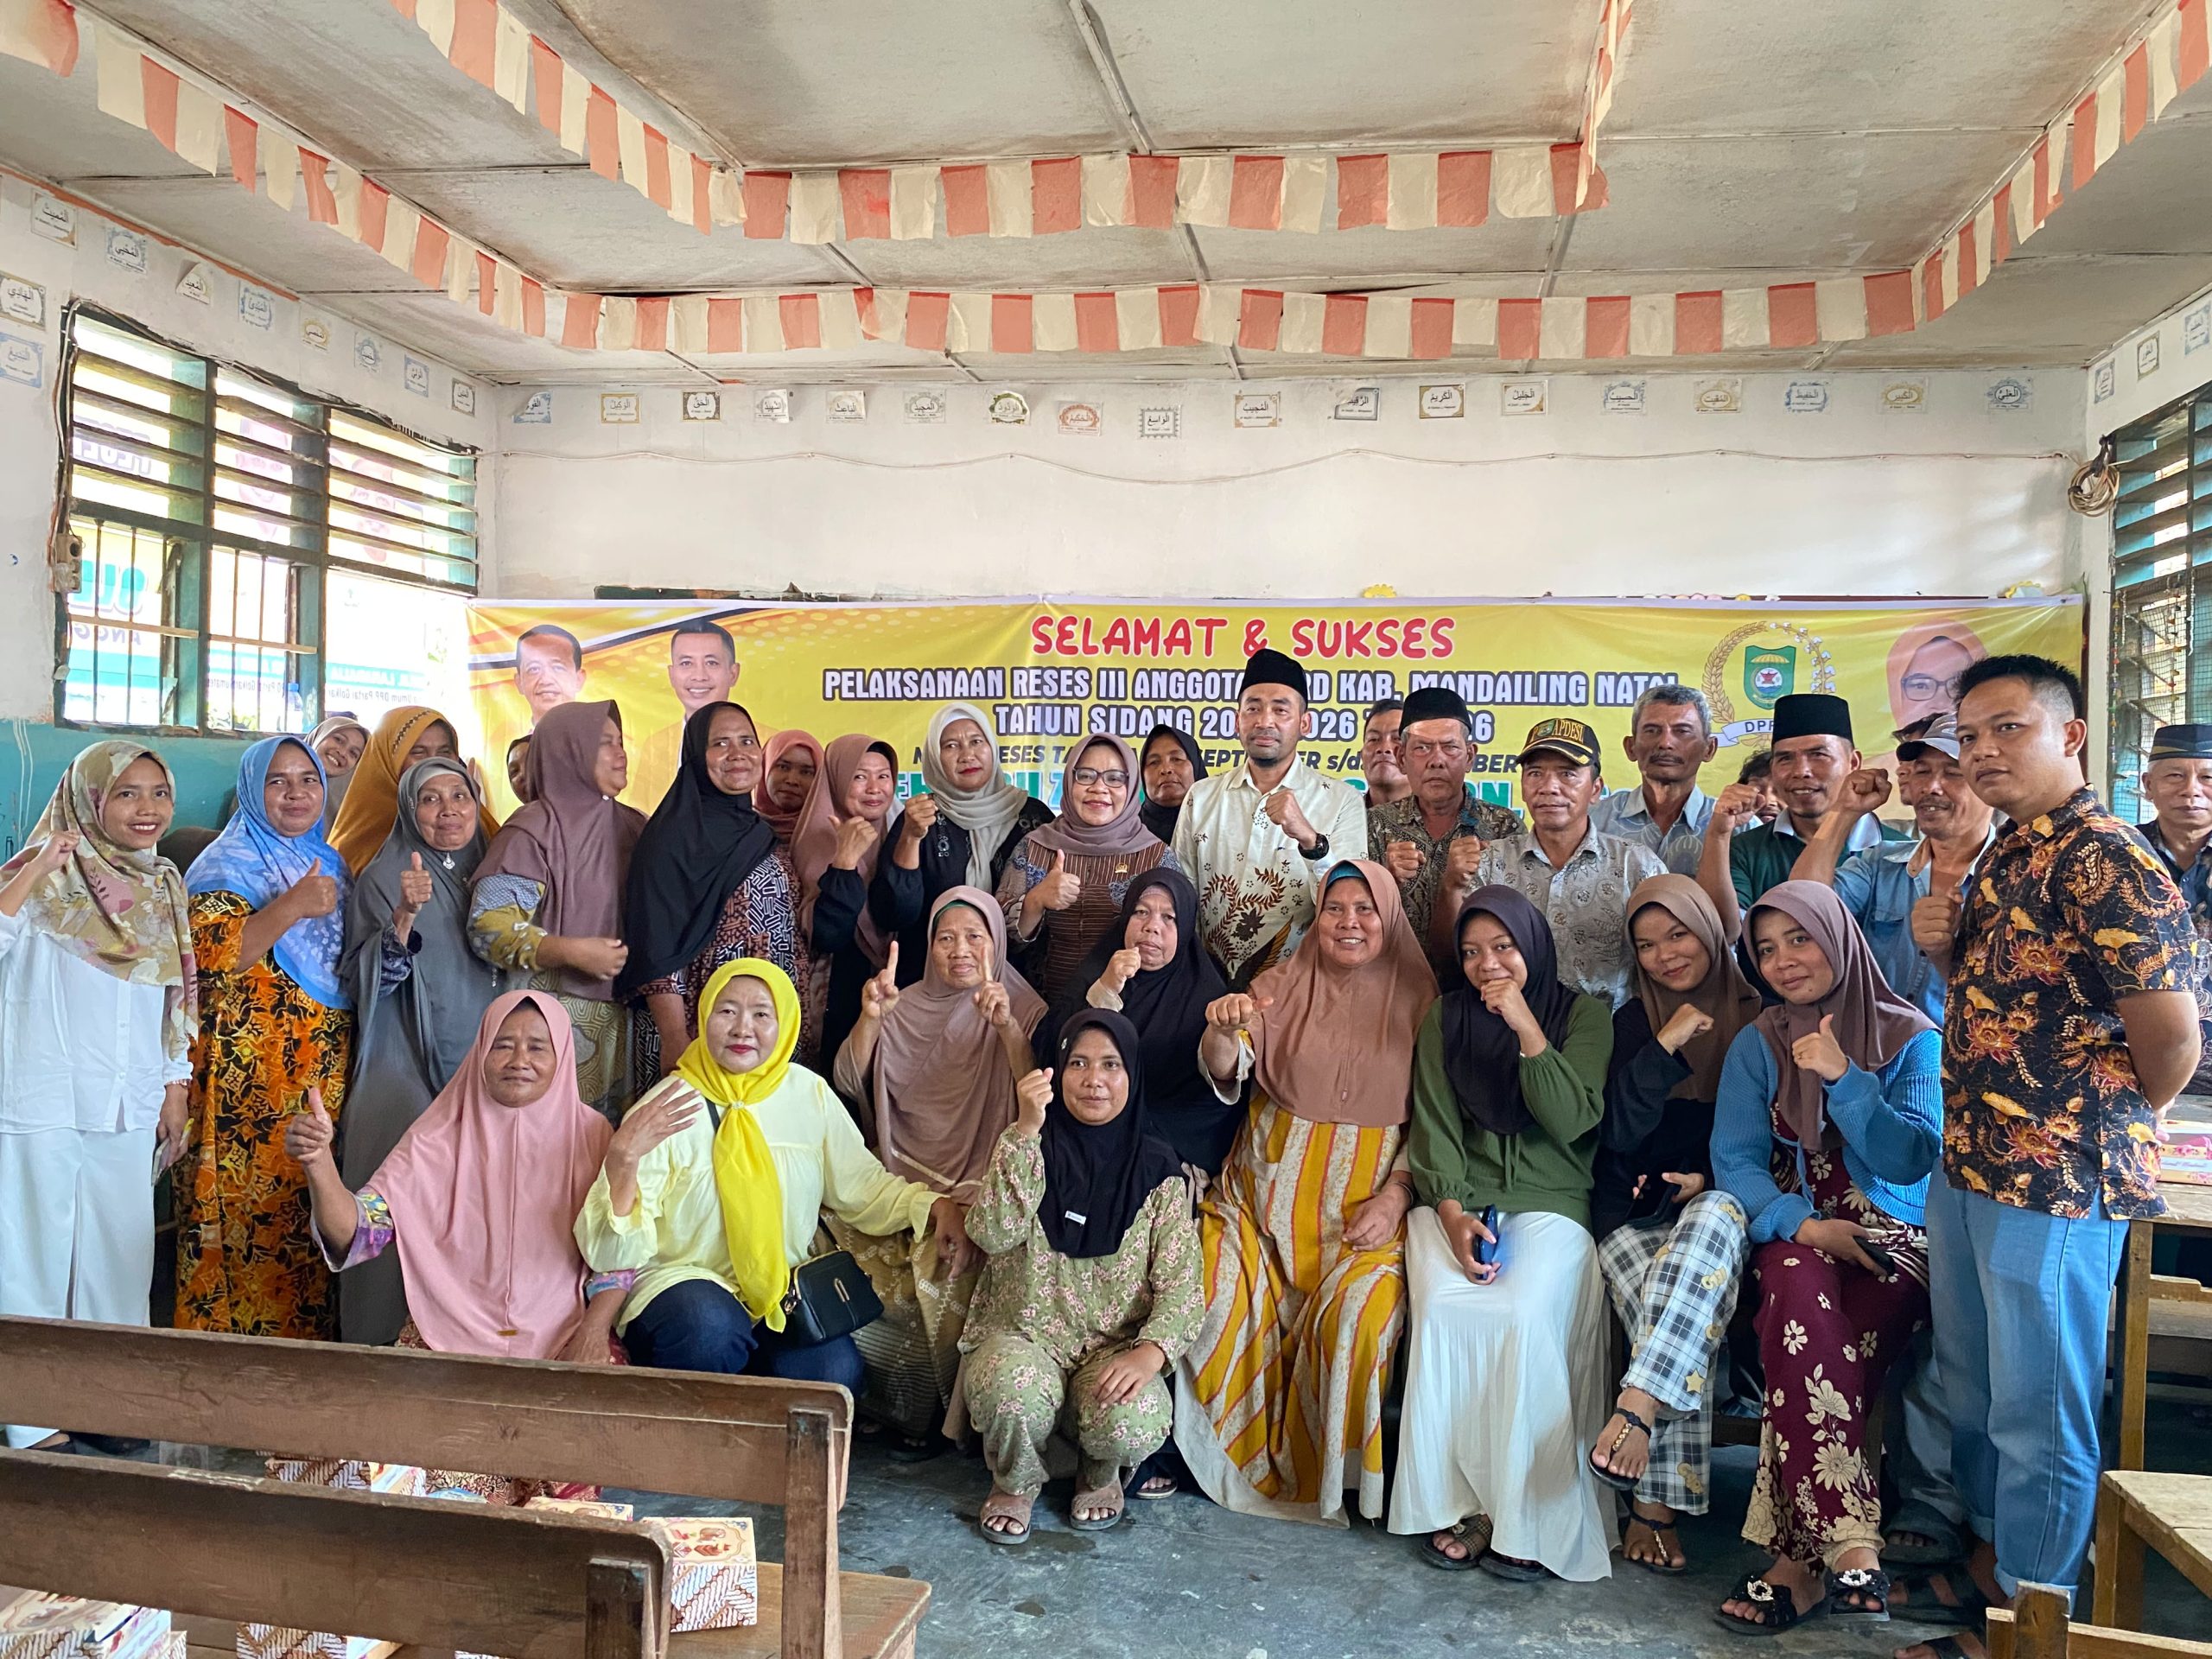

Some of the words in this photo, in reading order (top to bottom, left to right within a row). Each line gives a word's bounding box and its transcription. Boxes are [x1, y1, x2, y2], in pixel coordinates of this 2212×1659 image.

[1033, 615, 1228, 658] SELAMAT
[1243, 619, 1268, 657] &
[1292, 618, 1455, 659] SUKSES
[824, 669, 1004, 698] PELAKSANAAN
[1012, 669, 1090, 698] RESES
[1099, 670, 1126, 698] III
[1339, 672, 1401, 701] KAB.
[1598, 675, 1676, 704] NAT
[995, 705, 1080, 734] TAHUN
[1090, 707, 1193, 737] SIDANG
[1745, 720, 1774, 733] DP
[1000, 745, 1046, 764] ESES
